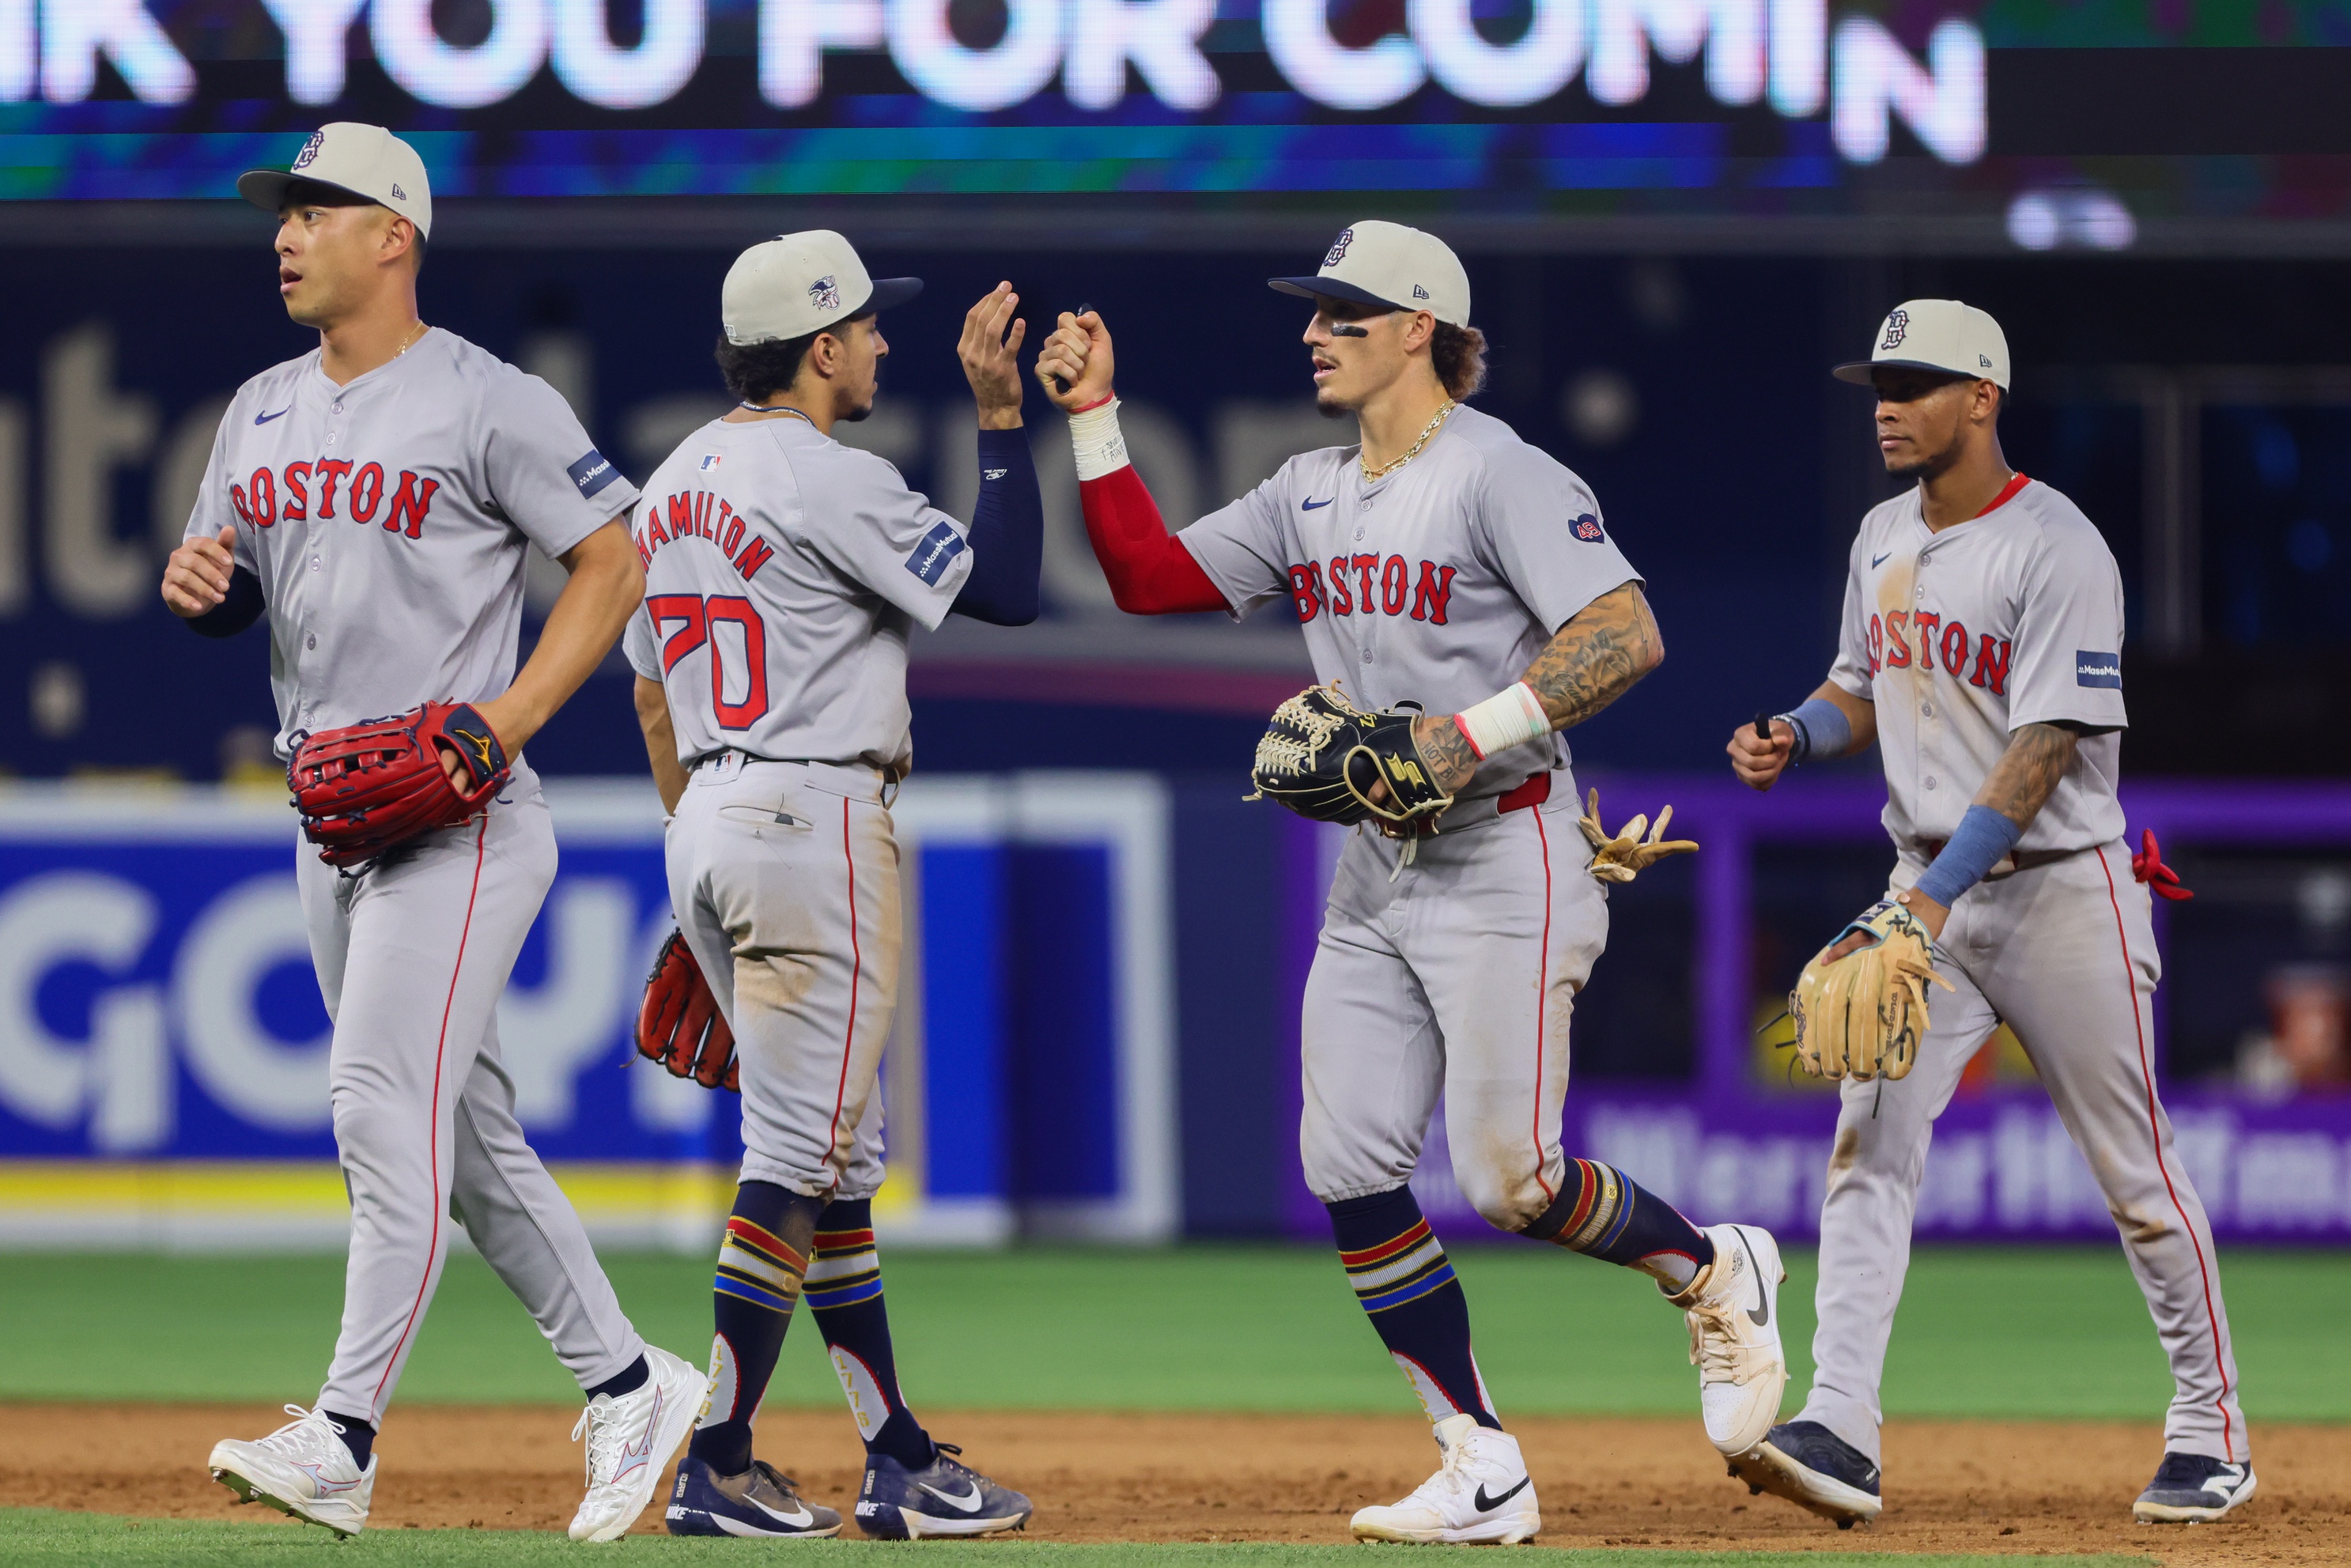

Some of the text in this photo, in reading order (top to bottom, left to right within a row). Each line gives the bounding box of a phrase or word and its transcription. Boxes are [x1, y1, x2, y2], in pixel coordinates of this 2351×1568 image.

[259, 0, 708, 110] YOU
[758, 0, 1223, 111] FOR
[1880, 309, 1910, 350] B
[232, 455, 440, 540] BOSTON
[1576, 521, 1601, 539] 49
[635, 489, 775, 583] HAMILTON
[922, 530, 958, 569] MassMutual
[1288, 551, 1457, 625] BOSTON
[644, 593, 769, 731] 70
[1865, 608, 2012, 697] OSTON
[665, 1505, 690, 1521] NIKE
[855, 1502, 879, 1517] NIKE
